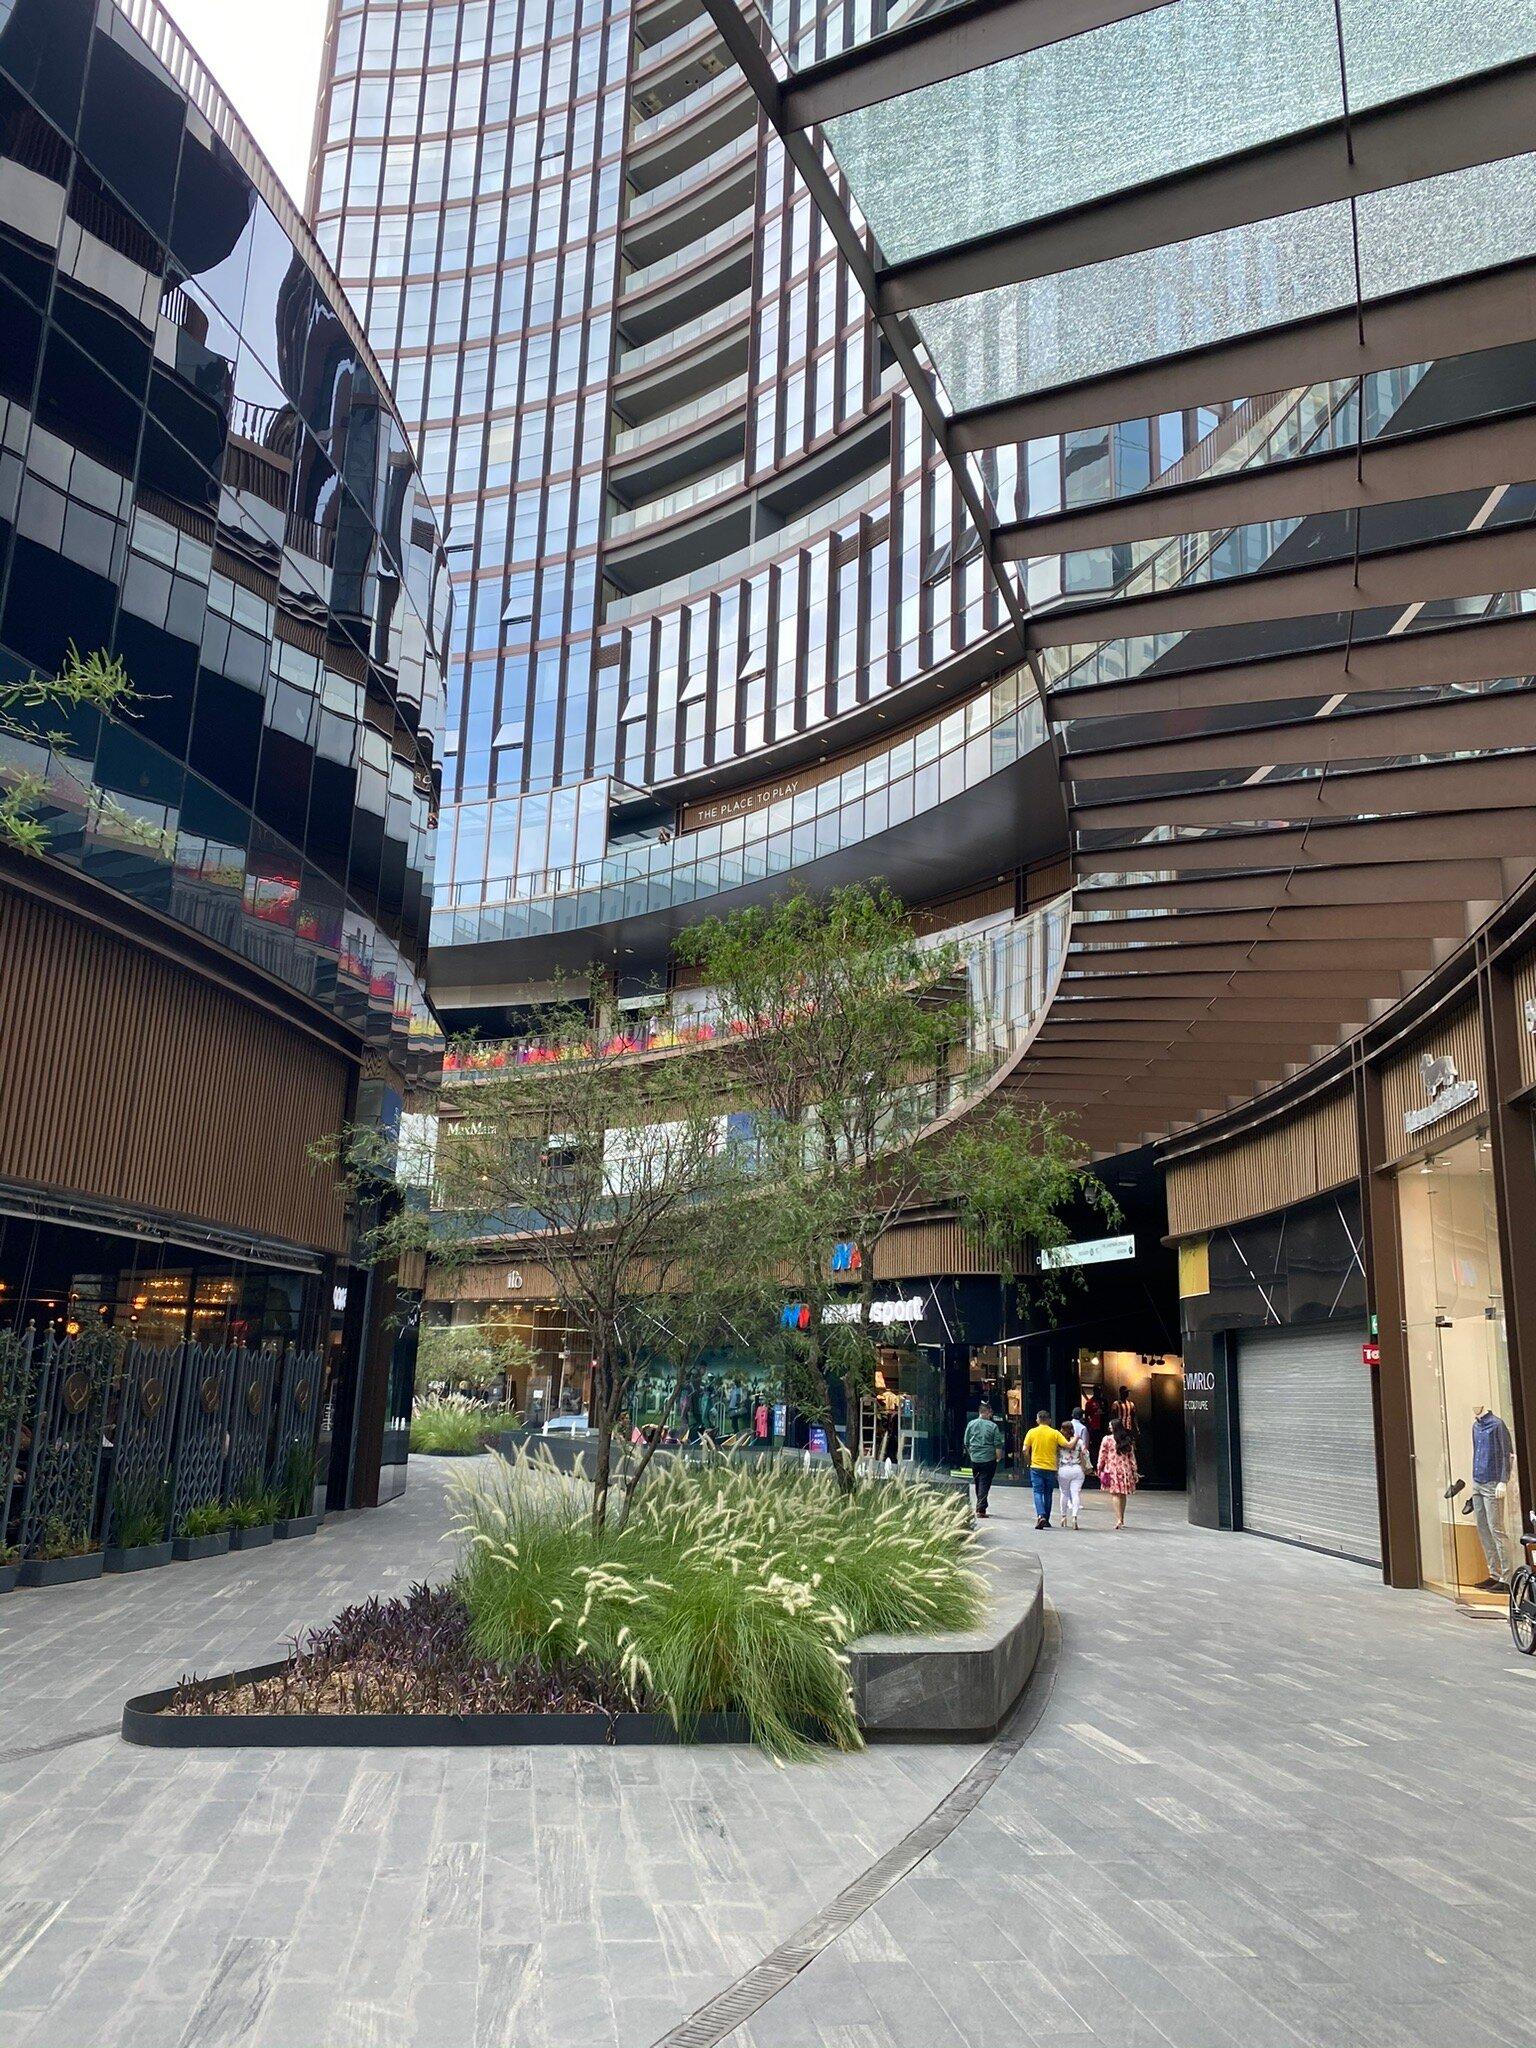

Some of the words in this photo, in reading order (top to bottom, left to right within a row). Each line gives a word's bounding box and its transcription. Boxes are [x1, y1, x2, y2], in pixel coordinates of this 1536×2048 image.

[698, 807, 718, 820] THE
[720, 797, 753, 815] PLACE
[757, 791, 771, 803] TO
[772, 781, 799, 798] PLAY
